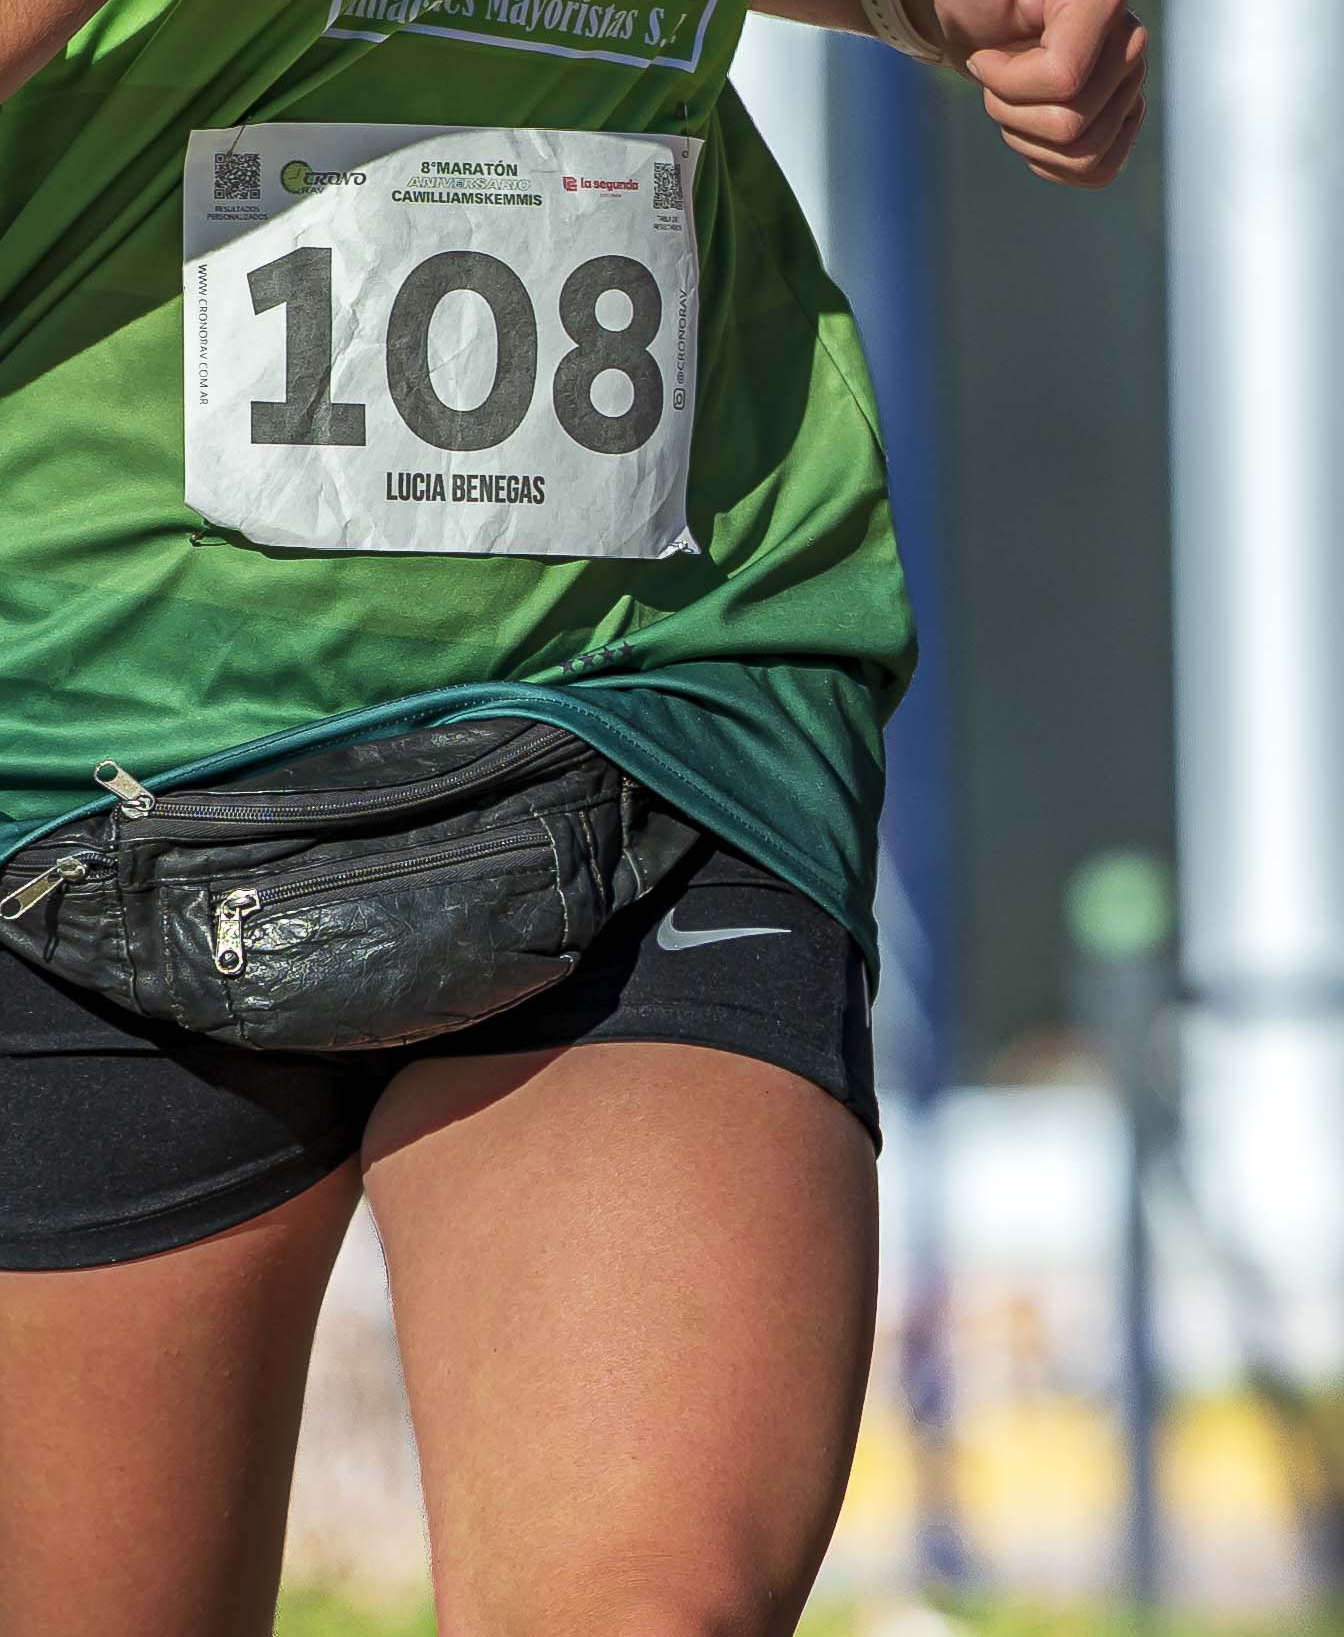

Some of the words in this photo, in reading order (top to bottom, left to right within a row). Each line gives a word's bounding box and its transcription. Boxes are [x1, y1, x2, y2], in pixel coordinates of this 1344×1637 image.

[407, 177, 531, 191] ANIVERSARIO
[580, 177, 592, 189] la
[593, 178, 639, 191] segunda
[391, 190, 543, 206] CAWILLIAMSKEMMIS
[677, 289, 688, 384] @CRONORAV
[246, 246, 664, 455] 108
[386, 472, 446, 503] LUCIA
[451, 474, 546, 505] BENEGAS
